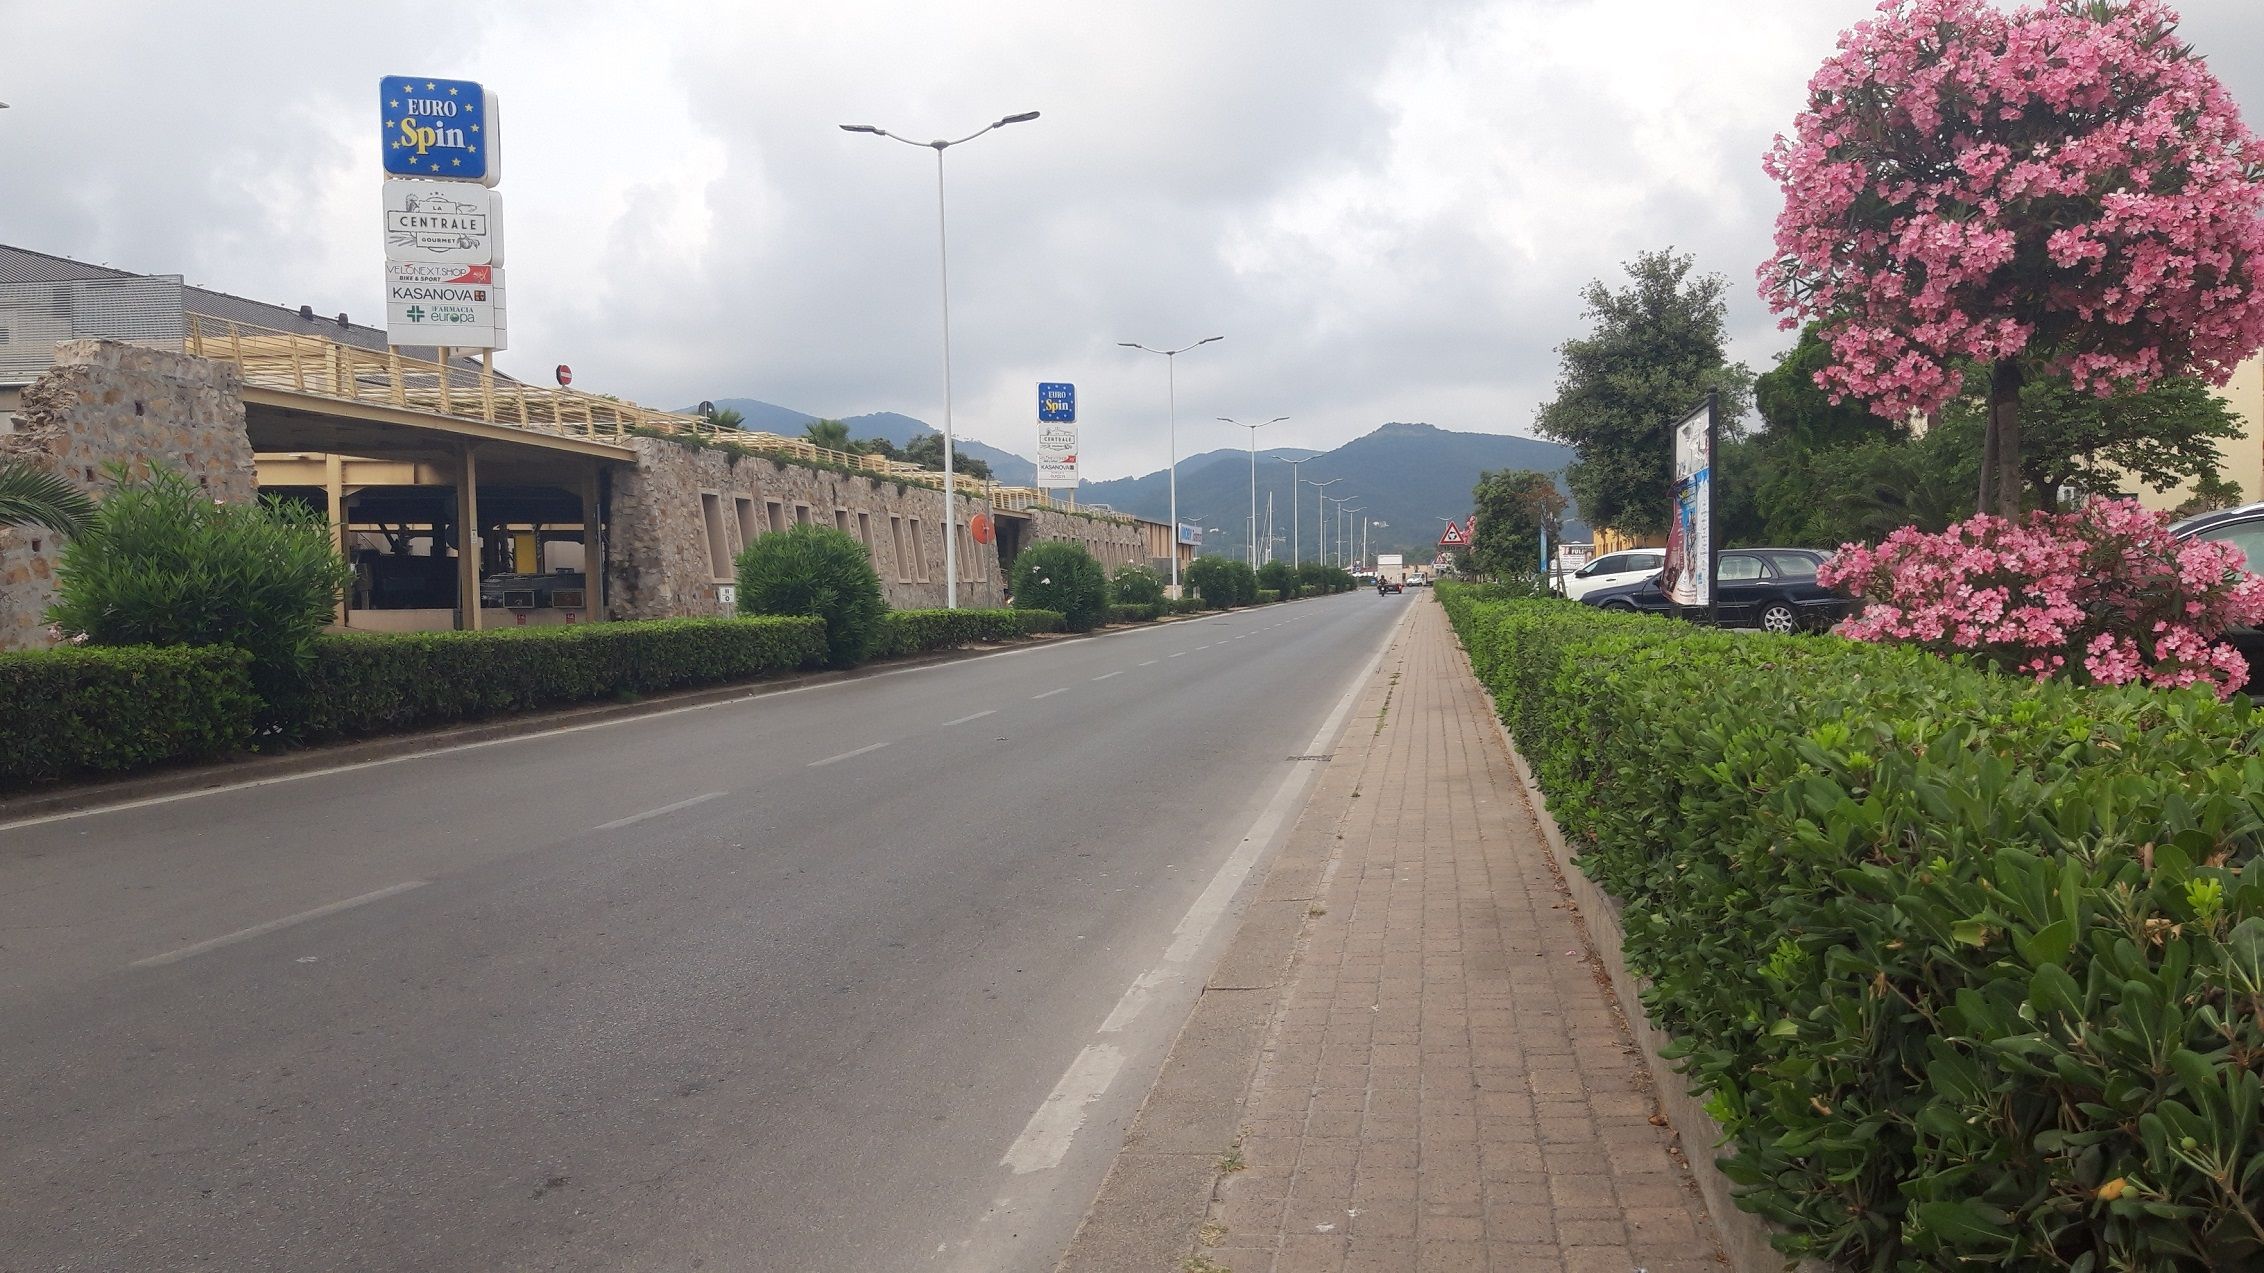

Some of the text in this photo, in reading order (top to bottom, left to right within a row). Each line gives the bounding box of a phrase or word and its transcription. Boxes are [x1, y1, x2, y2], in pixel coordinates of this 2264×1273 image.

[408, 99, 458, 117] EURO
[400, 117, 466, 155] Spin
[400, 216, 477, 230] CENTRALE
[393, 287, 473, 301] KASANOVA
[432, 305, 474, 313] FARMACIA
[431, 312, 475, 323] europa
[1048, 391, 1066, 399] EURO
[1045, 398, 1069, 413] Spin
